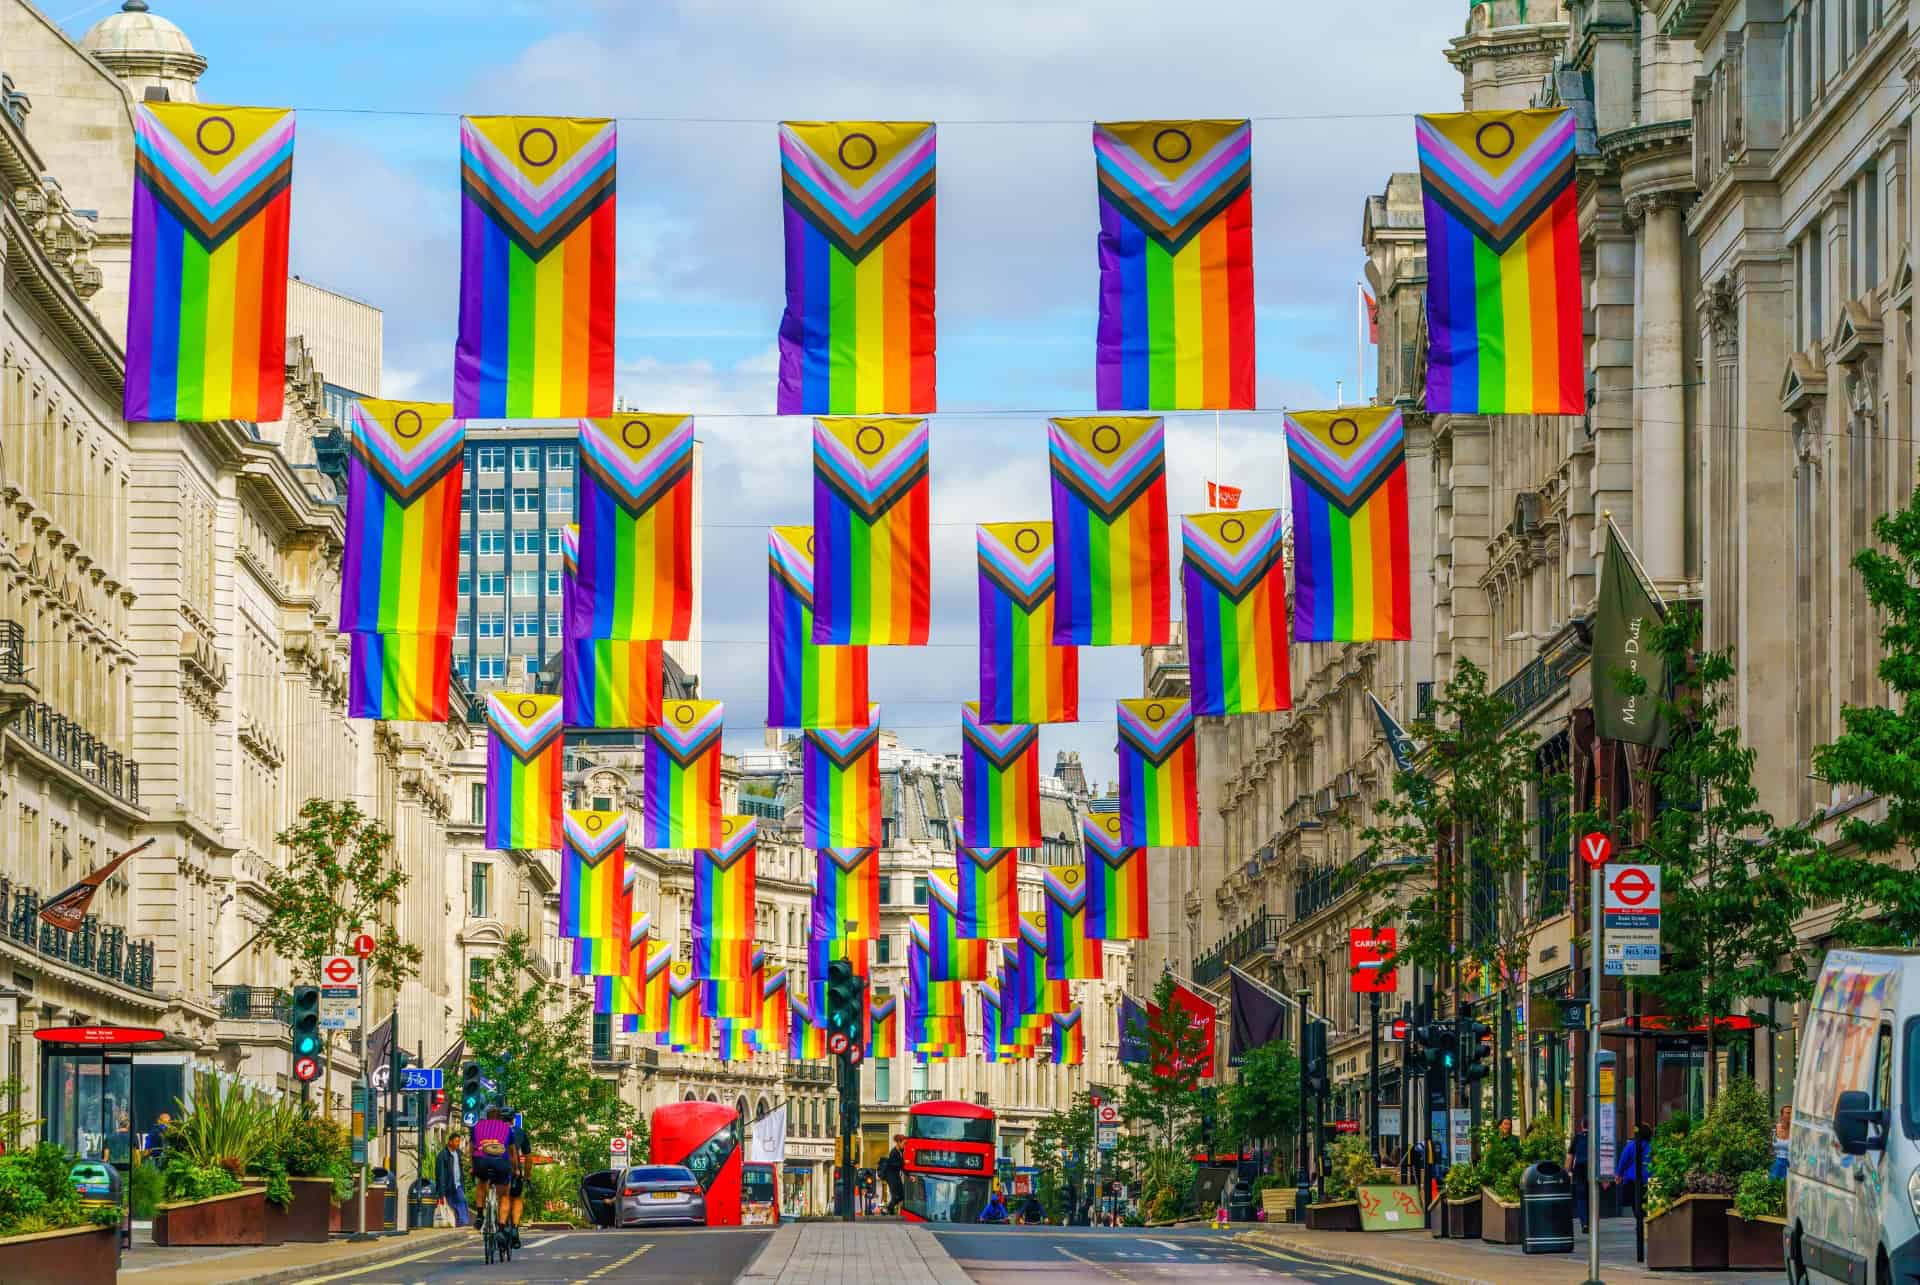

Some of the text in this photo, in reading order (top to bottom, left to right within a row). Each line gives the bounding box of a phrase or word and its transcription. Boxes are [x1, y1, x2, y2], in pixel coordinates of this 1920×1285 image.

[1622, 659, 1637, 726] Mamo
[1585, 838, 1605, 860] V
[360, 937, 370, 952] L
